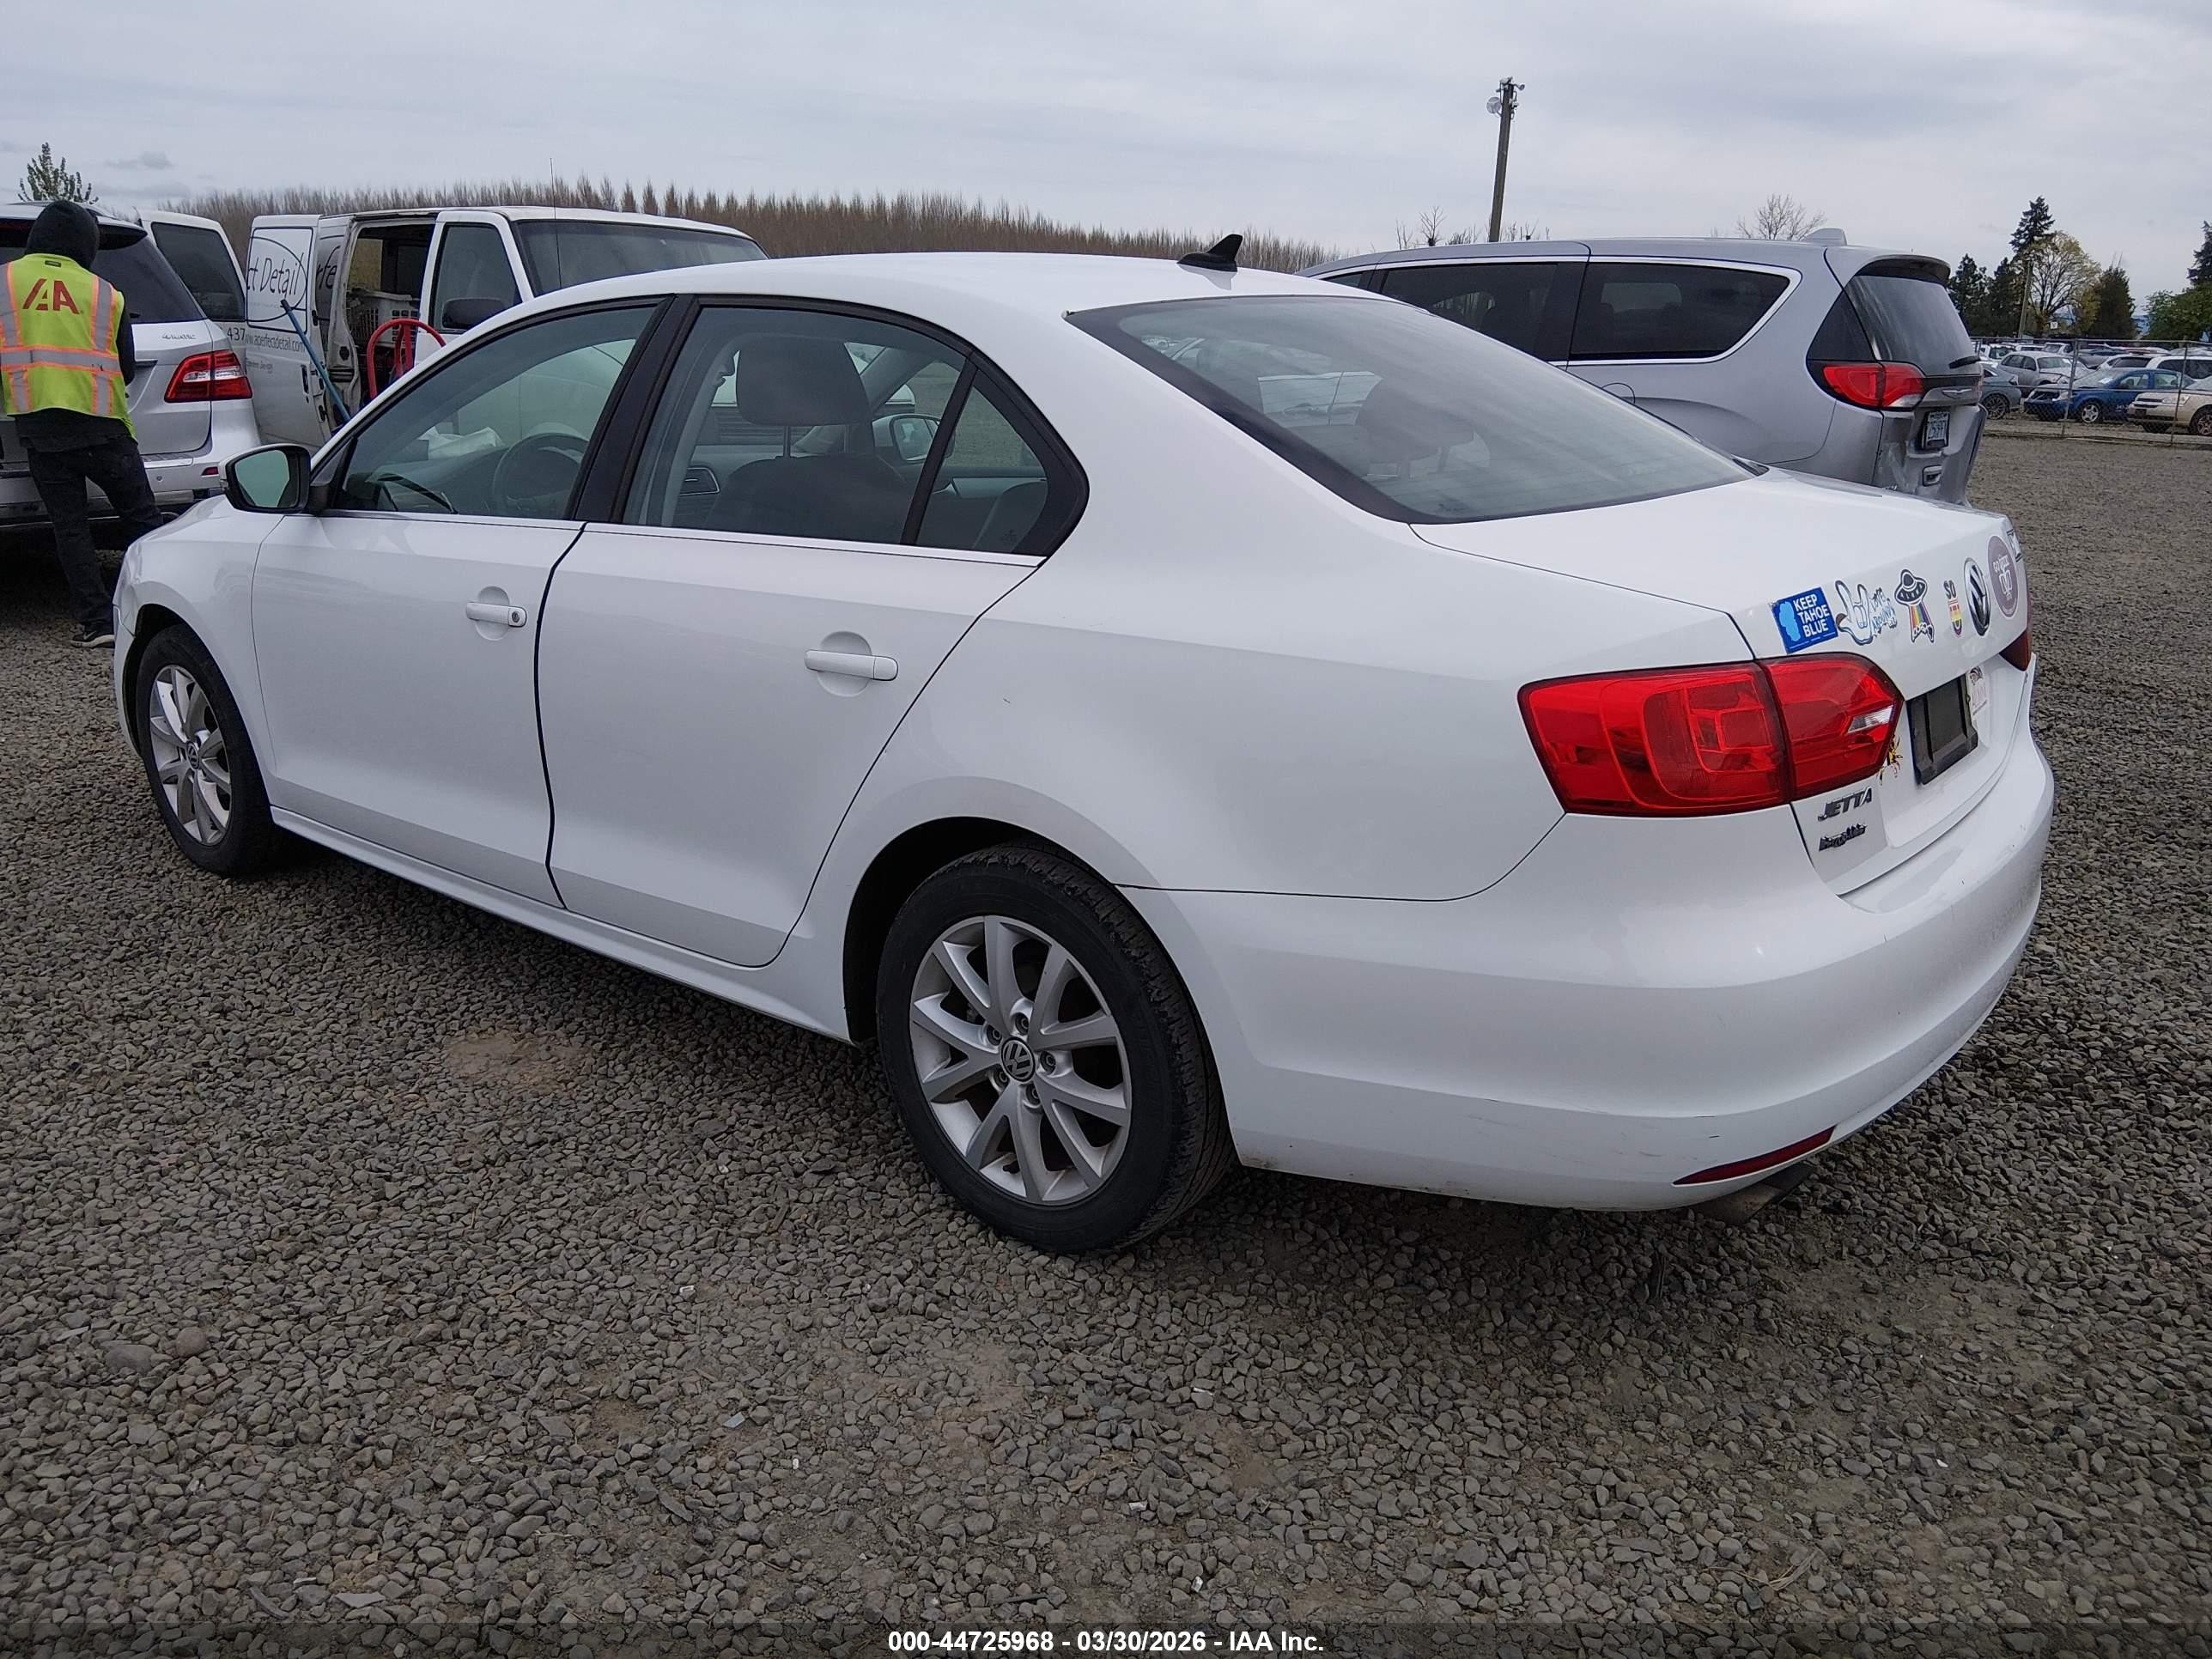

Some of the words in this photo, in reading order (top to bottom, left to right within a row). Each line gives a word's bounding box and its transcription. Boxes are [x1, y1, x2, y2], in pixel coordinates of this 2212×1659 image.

[260, 252, 304, 298] Detail
[227, 327, 246, 343] 437
[1793, 593, 1818, 612] KEEP
[1797, 604, 1830, 625] TAHOE
[1802, 618, 1829, 637] BLUE
[1818, 787, 1872, 822] JETTA
